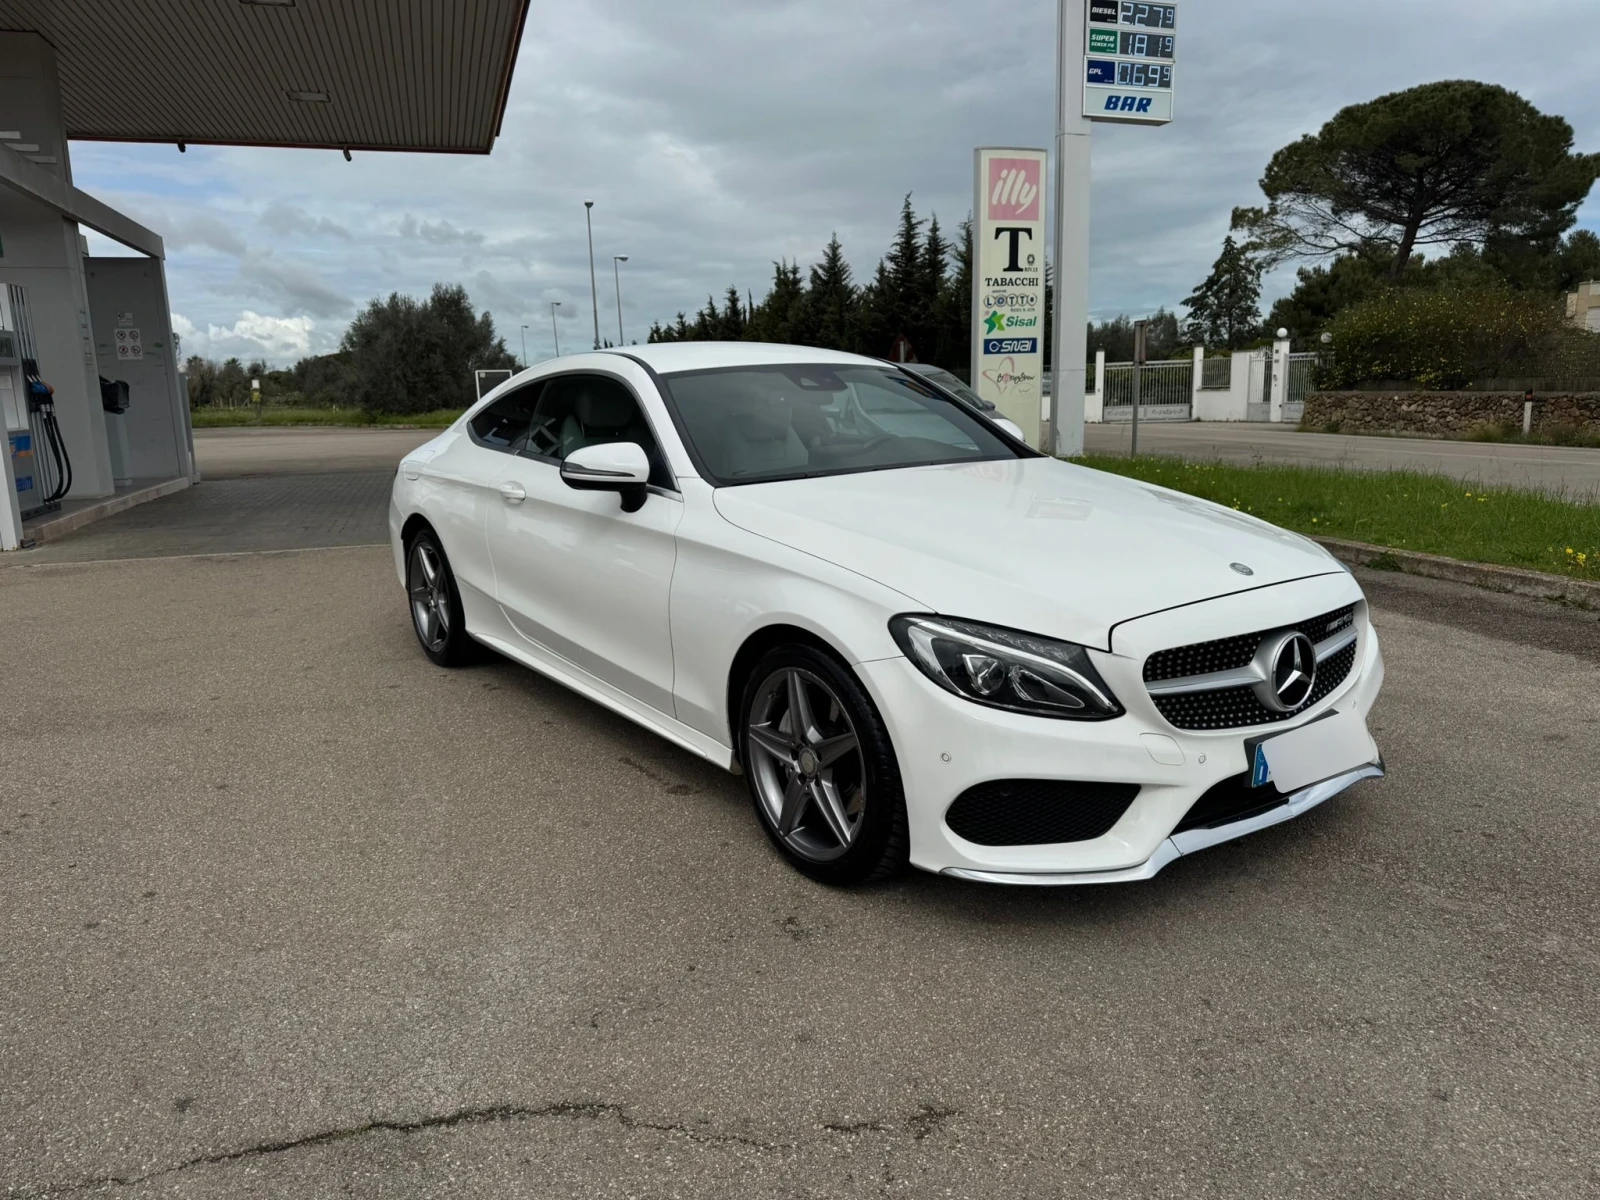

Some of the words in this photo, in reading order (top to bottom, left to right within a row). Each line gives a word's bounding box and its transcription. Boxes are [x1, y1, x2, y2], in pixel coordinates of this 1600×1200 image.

[1091, 6, 1117, 15] DIESEL
[1091, 34, 1115, 42] SUPER
[1104, 95, 1152, 113] BAR
[991, 168, 1037, 215] illy
[994, 227, 1033, 272] T
[985, 277, 1039, 287] TABACCHI
[984, 294, 1037, 308] LOTTO
[1005, 316, 1037, 327] Sisal
